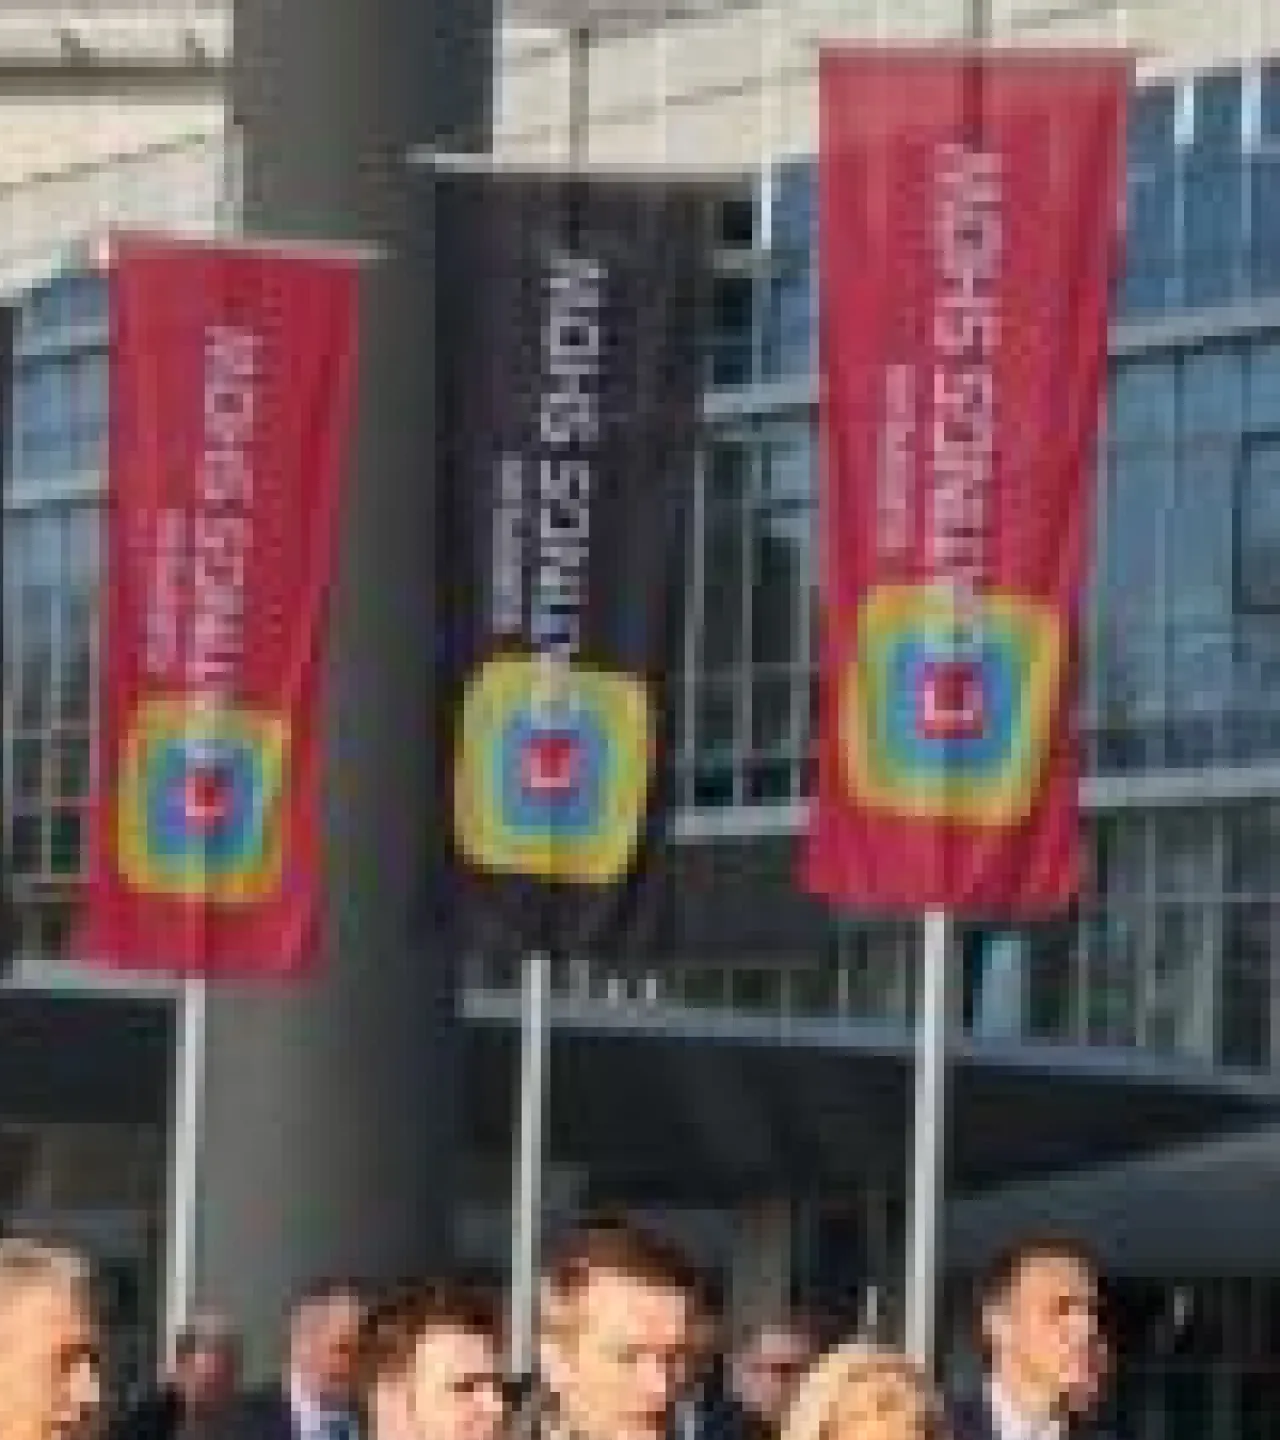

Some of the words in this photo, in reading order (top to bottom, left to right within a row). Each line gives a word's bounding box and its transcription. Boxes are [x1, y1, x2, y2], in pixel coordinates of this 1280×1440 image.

[933, 143, 1003, 358] SHOW
[195, 324, 263, 500] SHOW
[541, 258, 608, 442] SHOW
